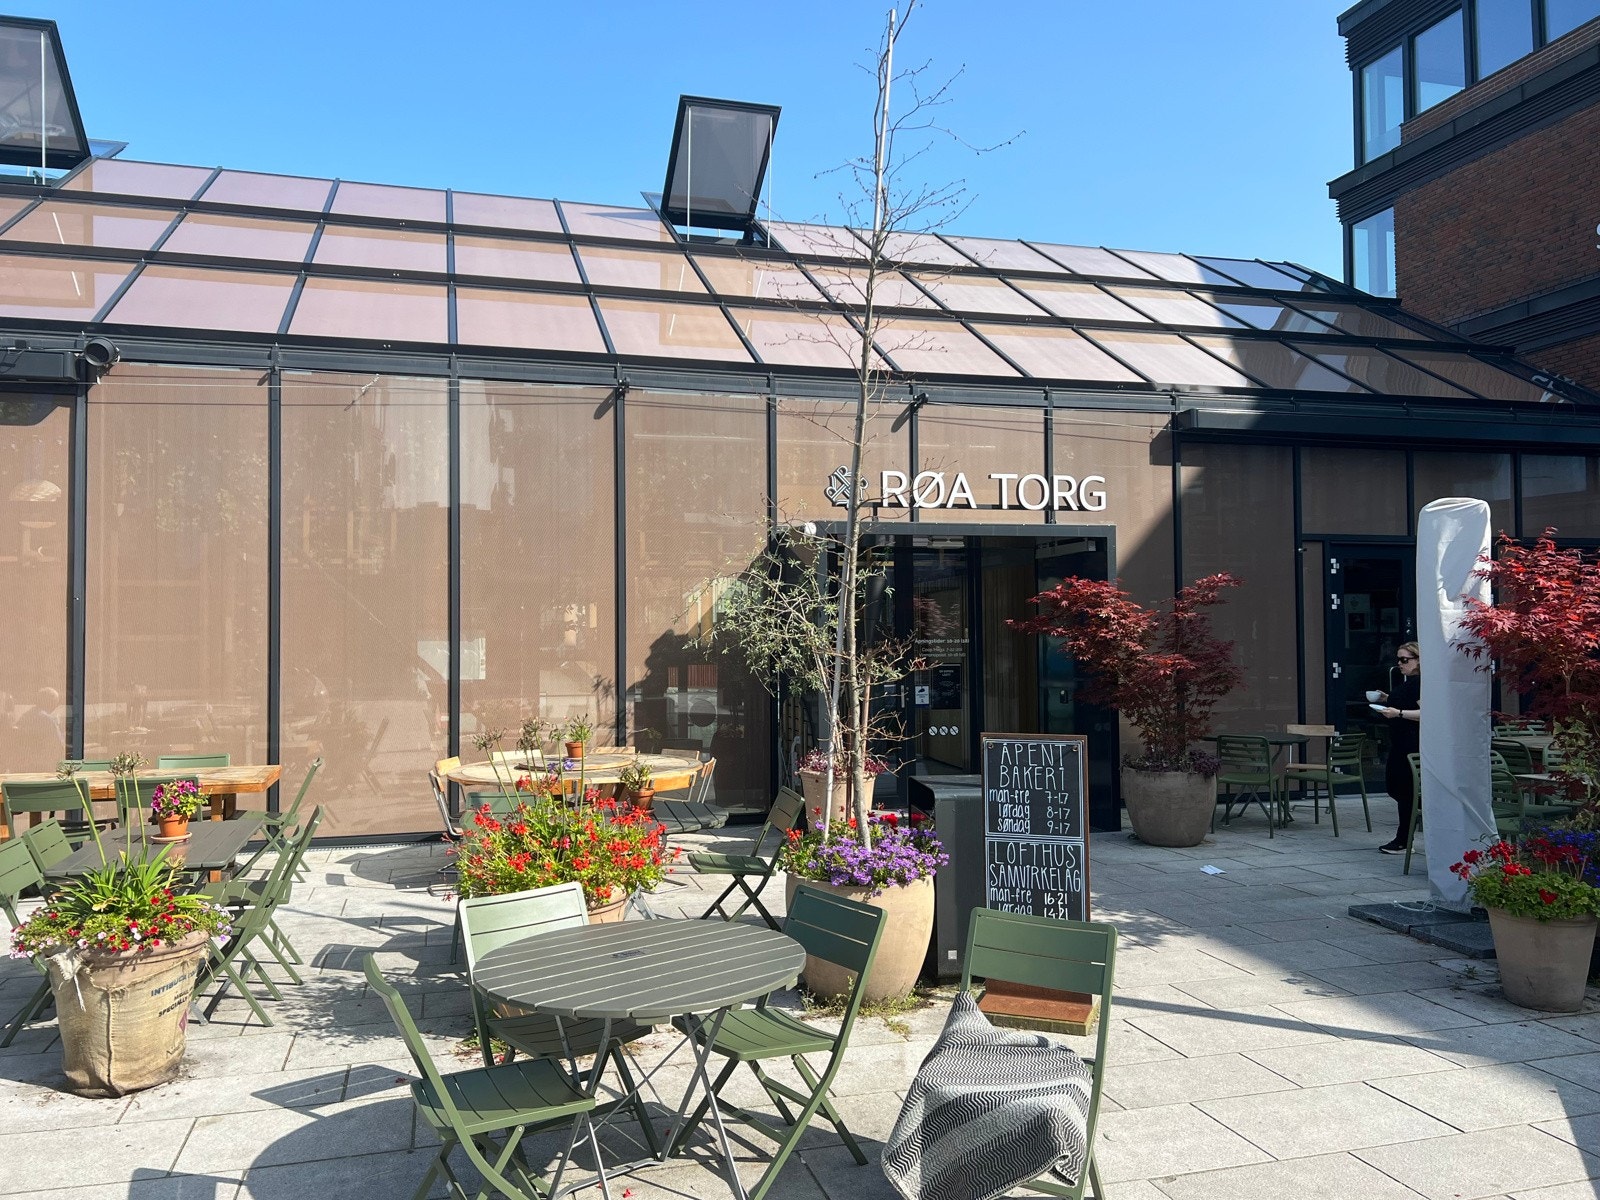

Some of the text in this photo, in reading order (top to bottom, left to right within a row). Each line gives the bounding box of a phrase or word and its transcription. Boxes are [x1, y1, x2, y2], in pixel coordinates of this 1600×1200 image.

[881, 470, 1107, 511] RØA TORG
[1000, 742, 1066, 767] ÅPENT
[1000, 765, 1065, 790] BAKERI
[989, 788, 1030, 804] man-fre
[998, 803, 1070, 820] lørdag 8-17
[997, 817, 1070, 835] søndag 9-17
[994, 841, 1076, 869] LOFTHUS
[989, 863, 1081, 893] SAMVIRKELAG
[990, 887, 1068, 905] man-fre 16-21
[158, 996, 188, 1018] SPECIALLY
